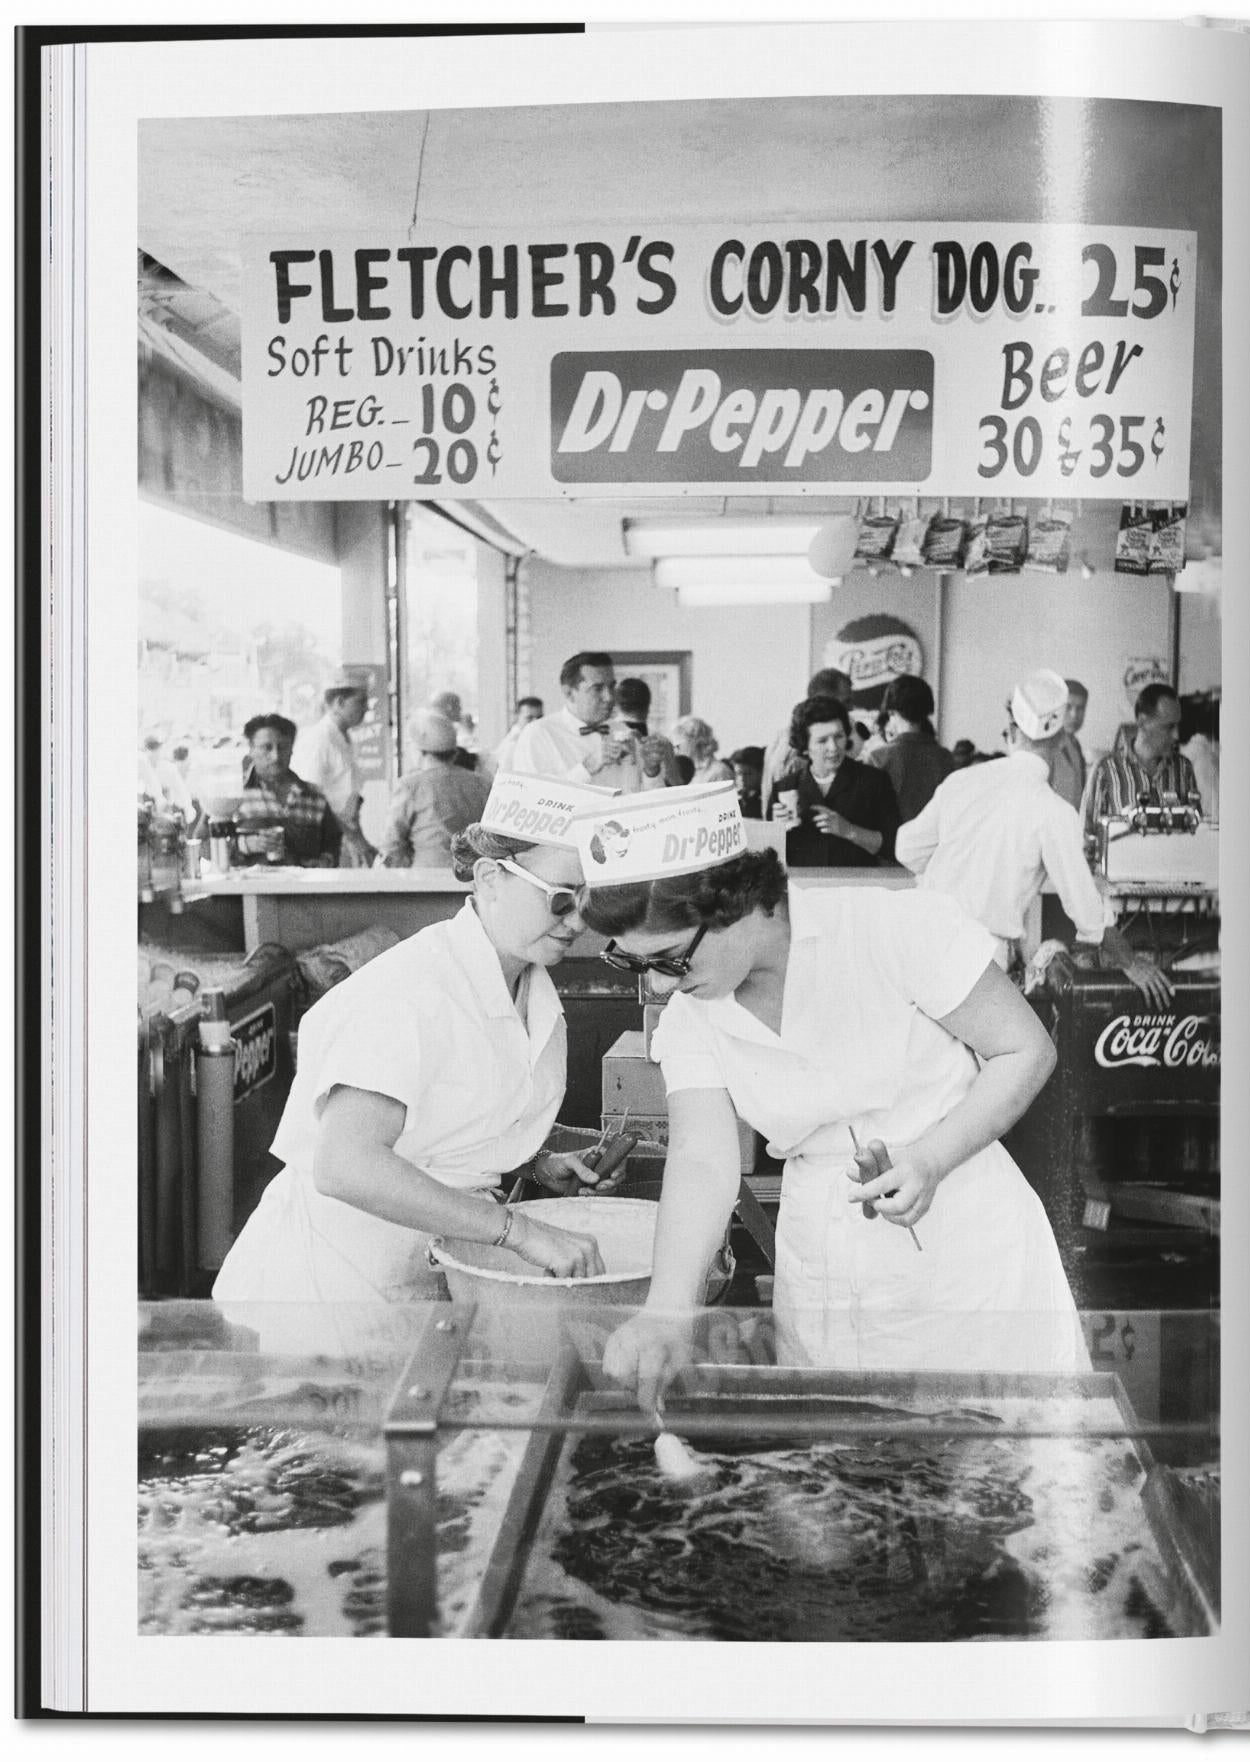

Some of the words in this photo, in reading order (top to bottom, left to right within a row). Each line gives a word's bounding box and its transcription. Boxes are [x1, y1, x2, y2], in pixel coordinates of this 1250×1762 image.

[269, 235, 677, 324] FLETCHER'S
[709, 238, 917, 318] CORNY
[267, 334, 353, 377] Soft
[371, 336, 498, 377] Drinks
[1000, 340, 1144, 411] Beer
[977, 414, 1043, 478] 30
[537, 797, 576, 813] DRINK
[1133, 1014, 1177, 1027] DRINK
